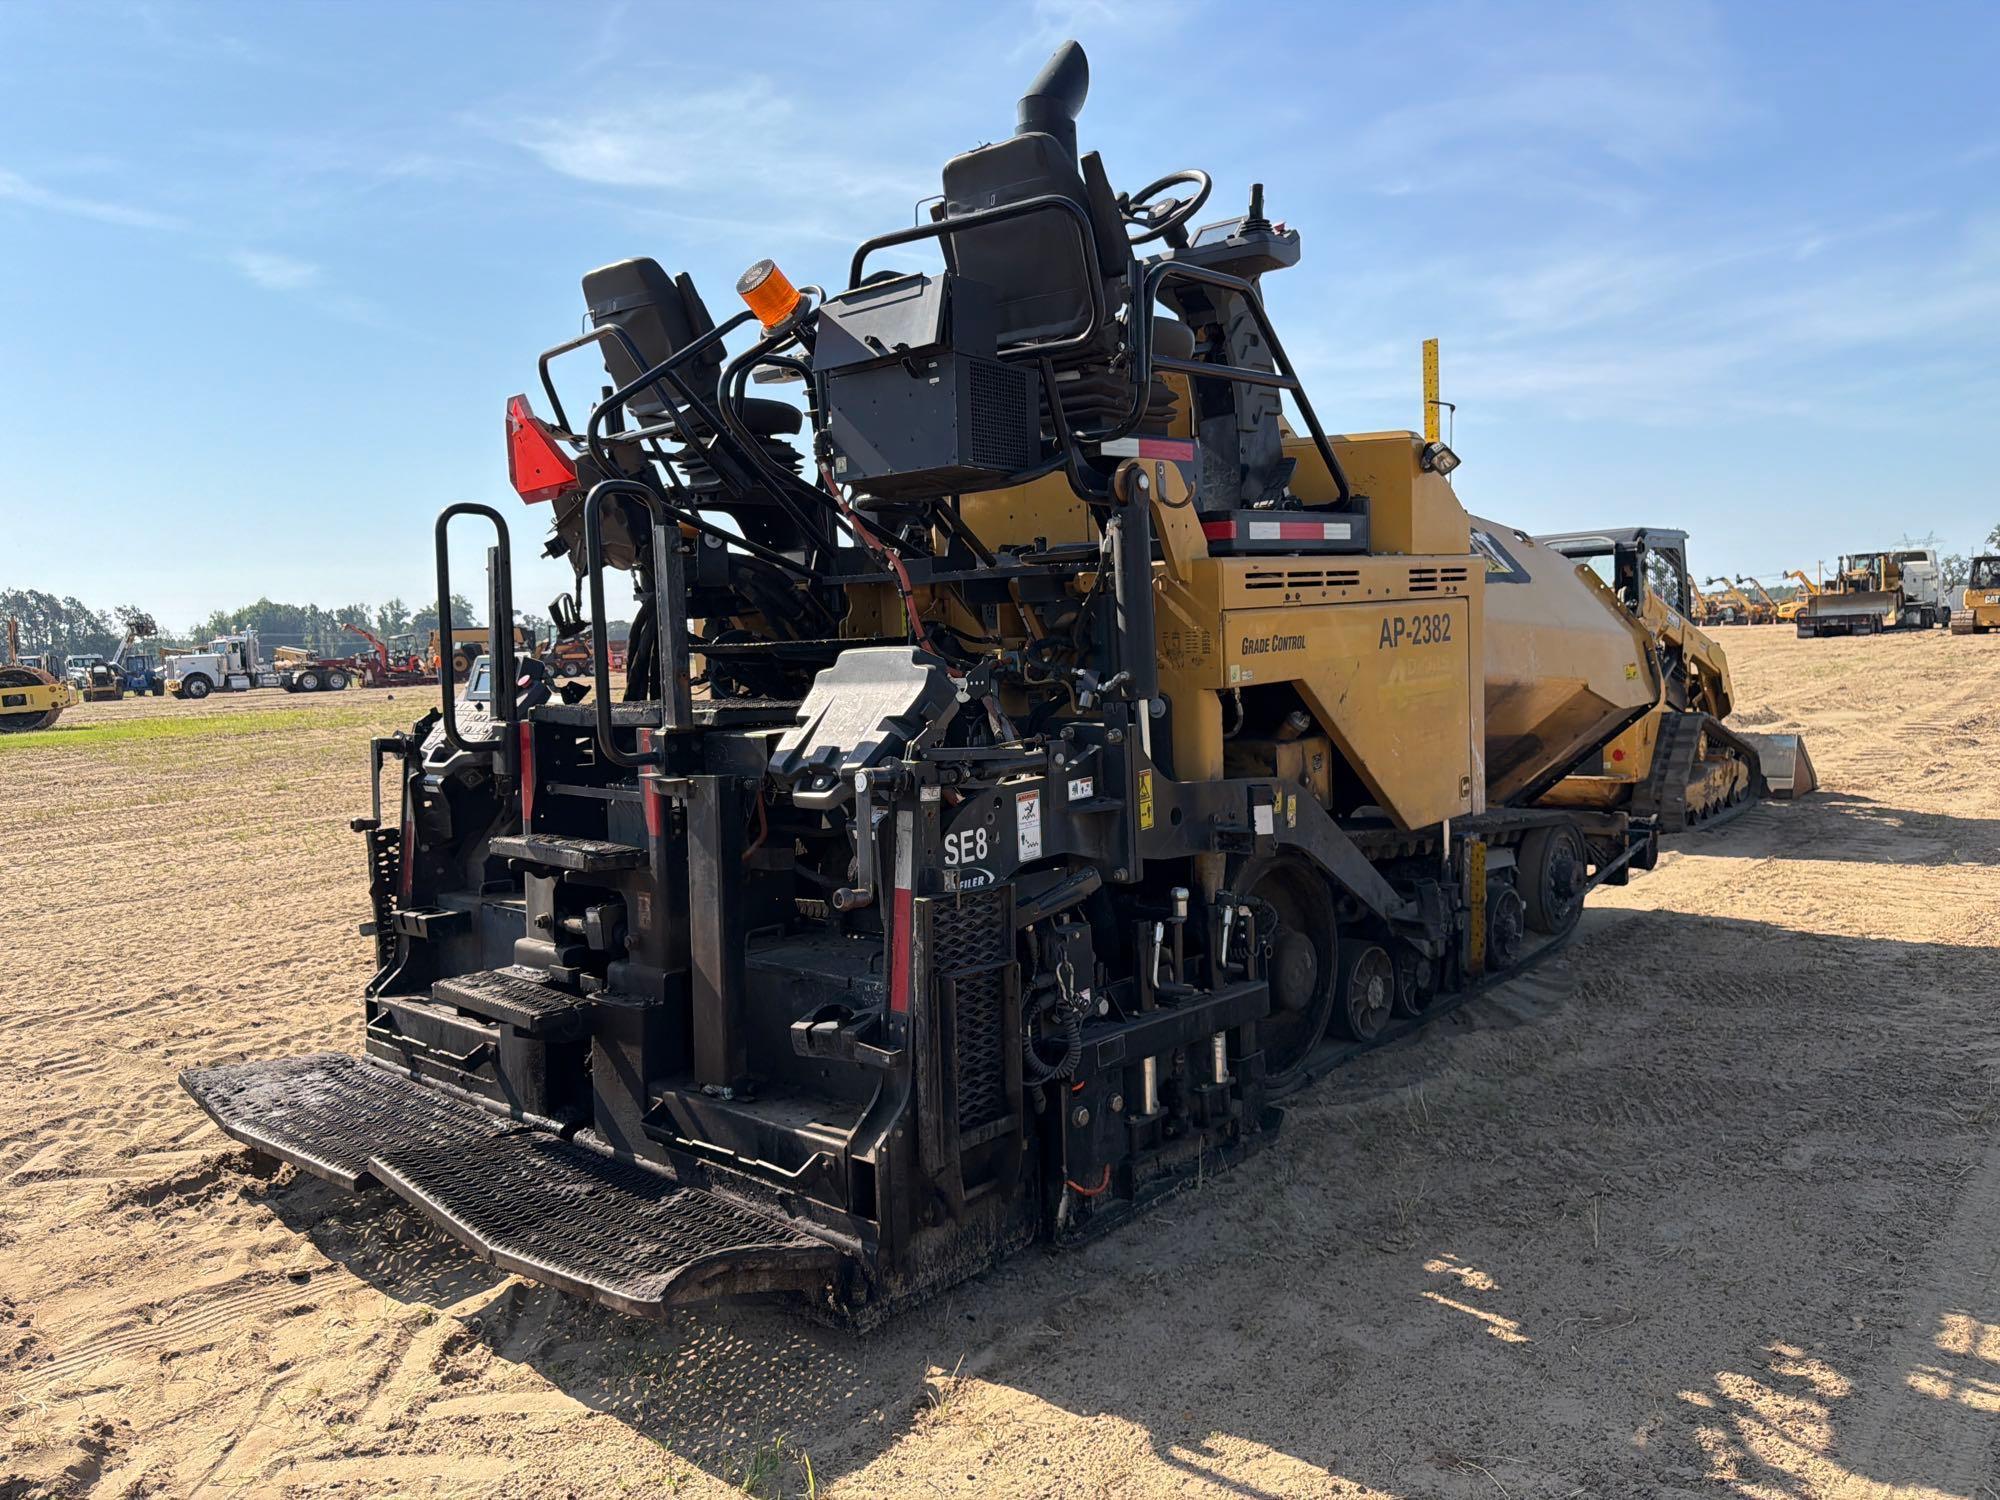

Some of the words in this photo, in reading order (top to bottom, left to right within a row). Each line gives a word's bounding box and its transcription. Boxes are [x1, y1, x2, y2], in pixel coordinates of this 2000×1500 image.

[1985, 595, 2000, 603] CAT
[1241, 637, 1270, 656] GRADE
[1271, 634, 1306, 652] CONTROL
[1378, 613, 1452, 650] AP-2382
[944, 828, 988, 864] SE8
